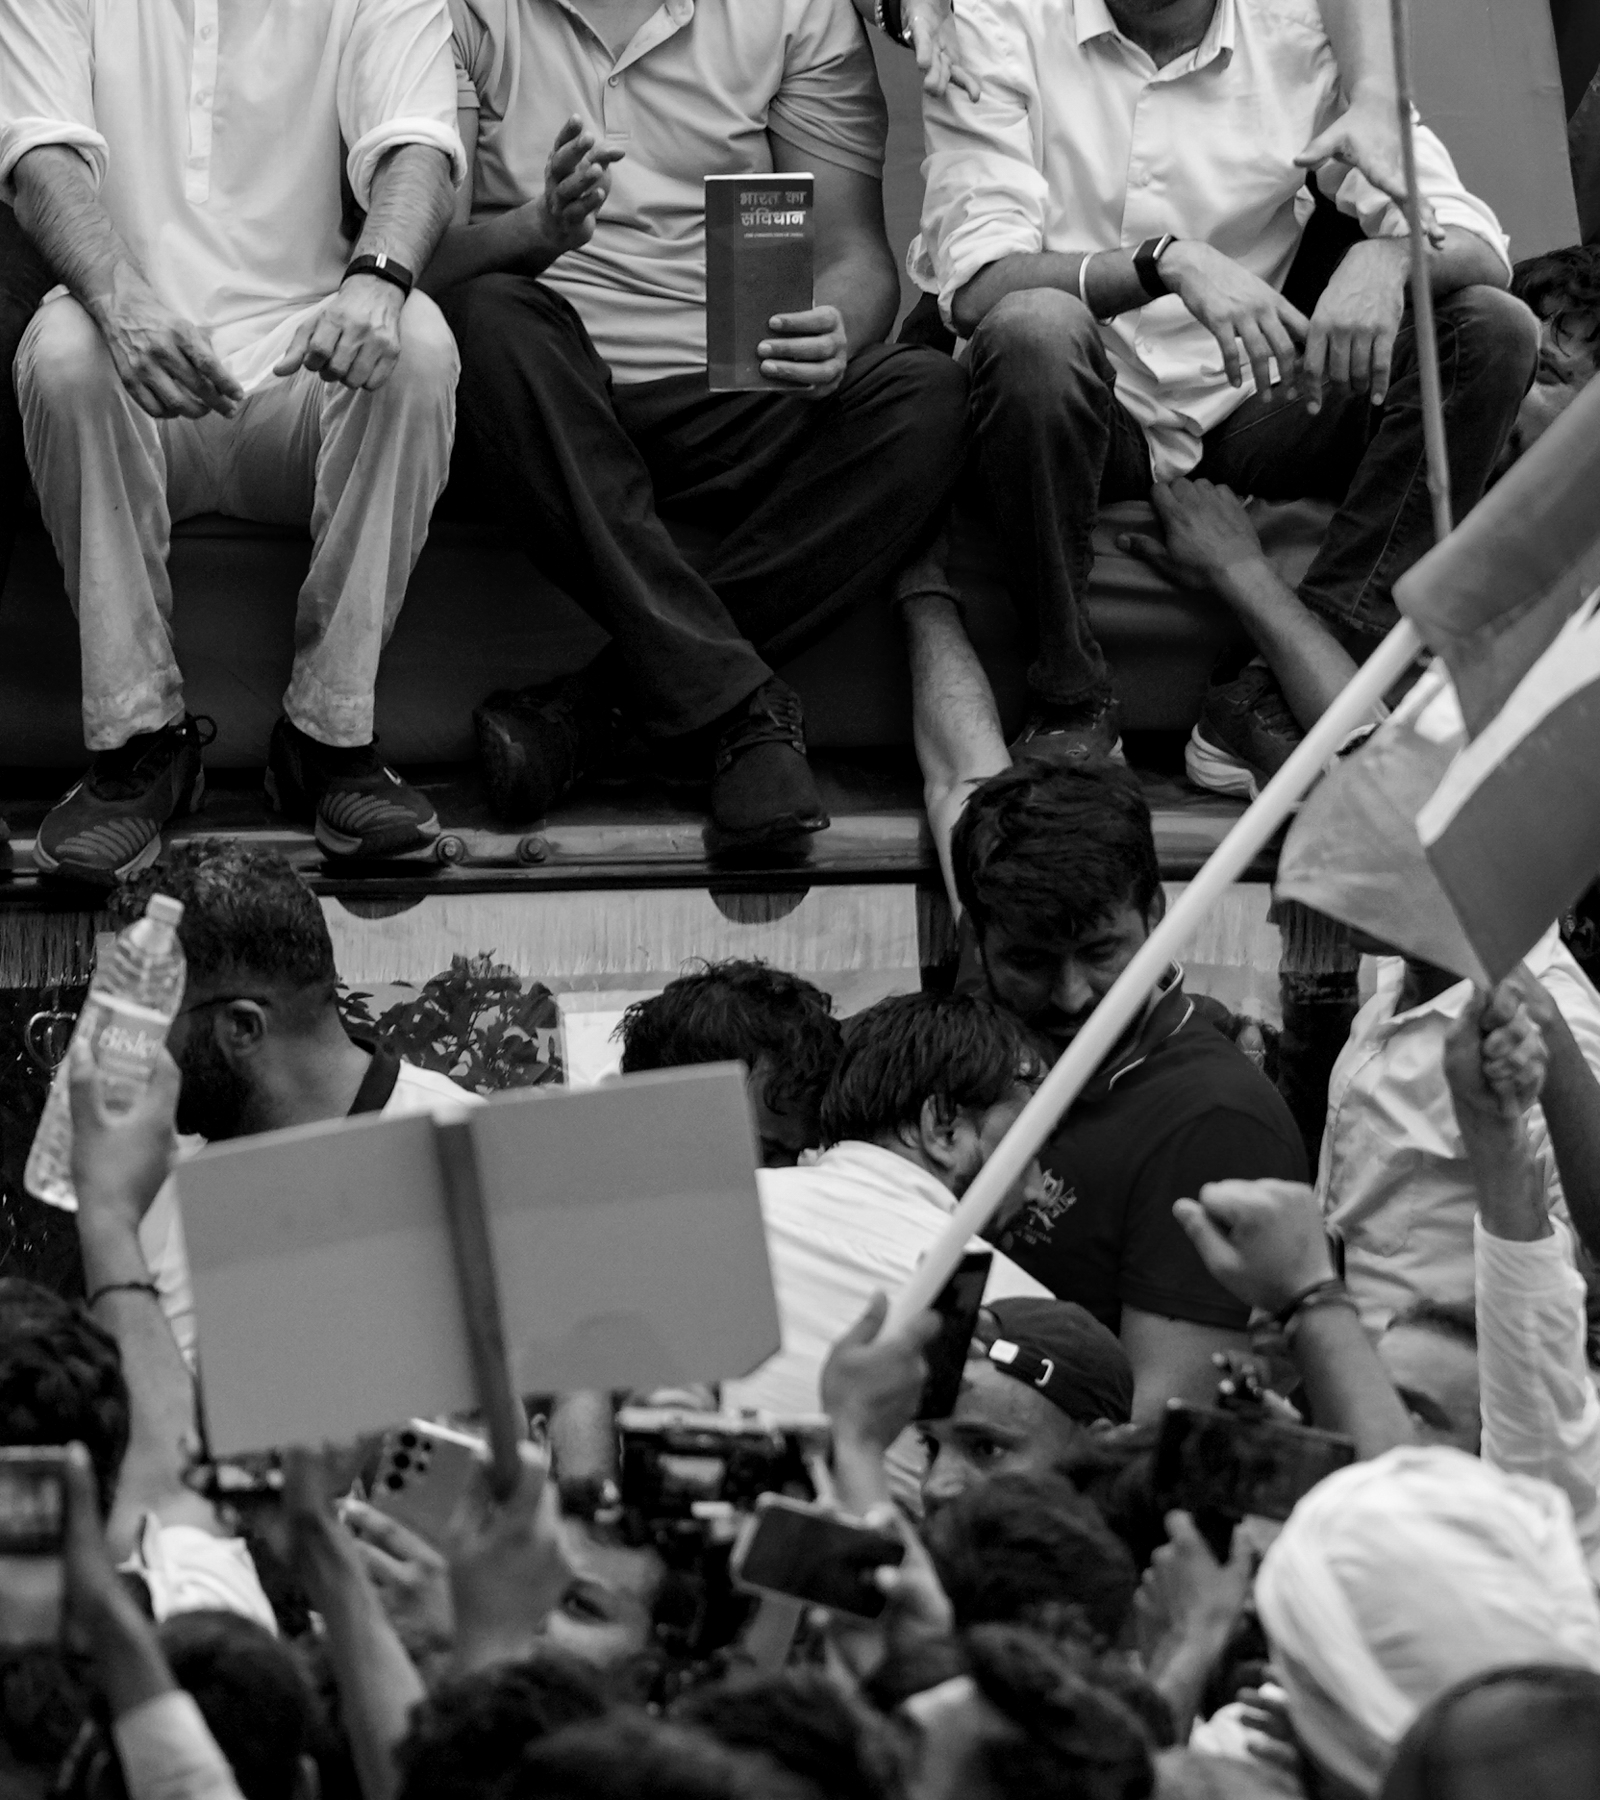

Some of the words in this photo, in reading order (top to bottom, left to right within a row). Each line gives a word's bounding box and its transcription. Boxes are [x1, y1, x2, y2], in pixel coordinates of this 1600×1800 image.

[740, 191, 781, 206] भारत
[785, 190, 807, 205] का
[741, 207, 806, 227] संविधान
